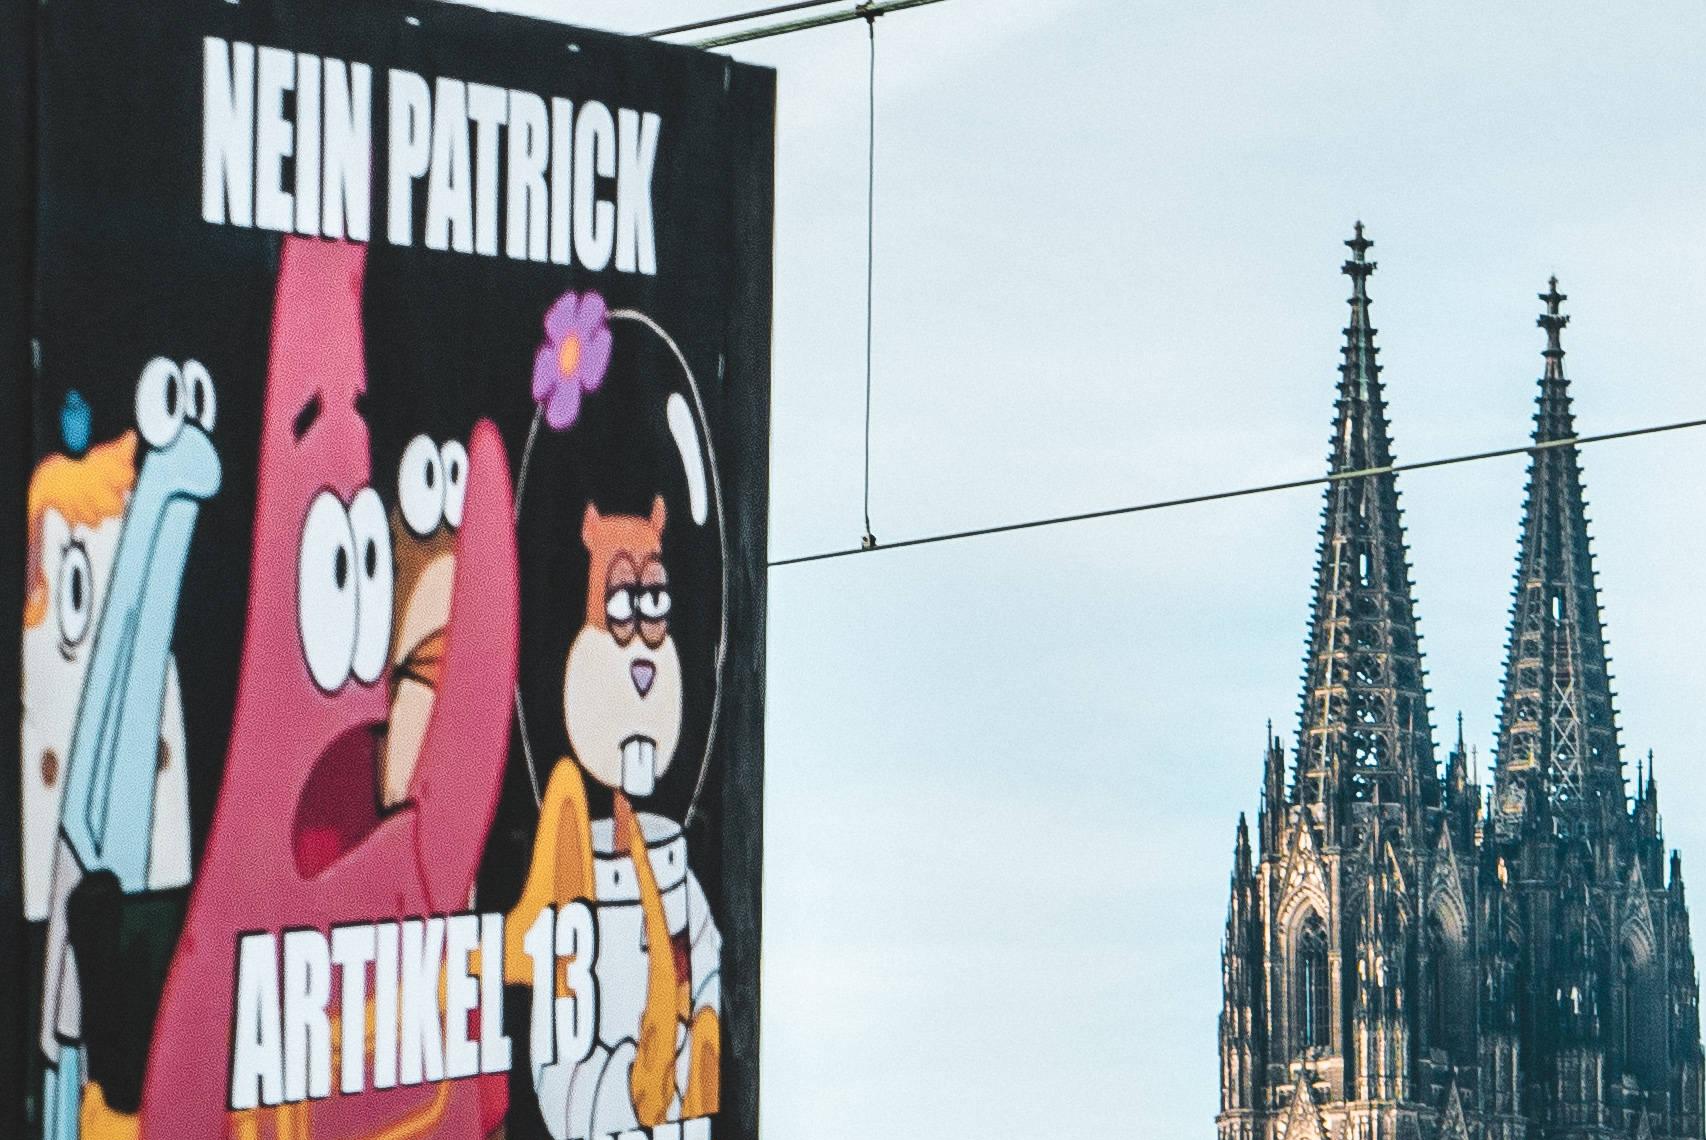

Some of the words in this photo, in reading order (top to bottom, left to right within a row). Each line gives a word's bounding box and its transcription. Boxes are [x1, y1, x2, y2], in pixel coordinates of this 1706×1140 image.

[202, 36, 372, 242] NEIN
[388, 69, 661, 275] PATRICK
[231, 912, 512, 1110] ARTIKEL
[524, 902, 595, 1065] 13
